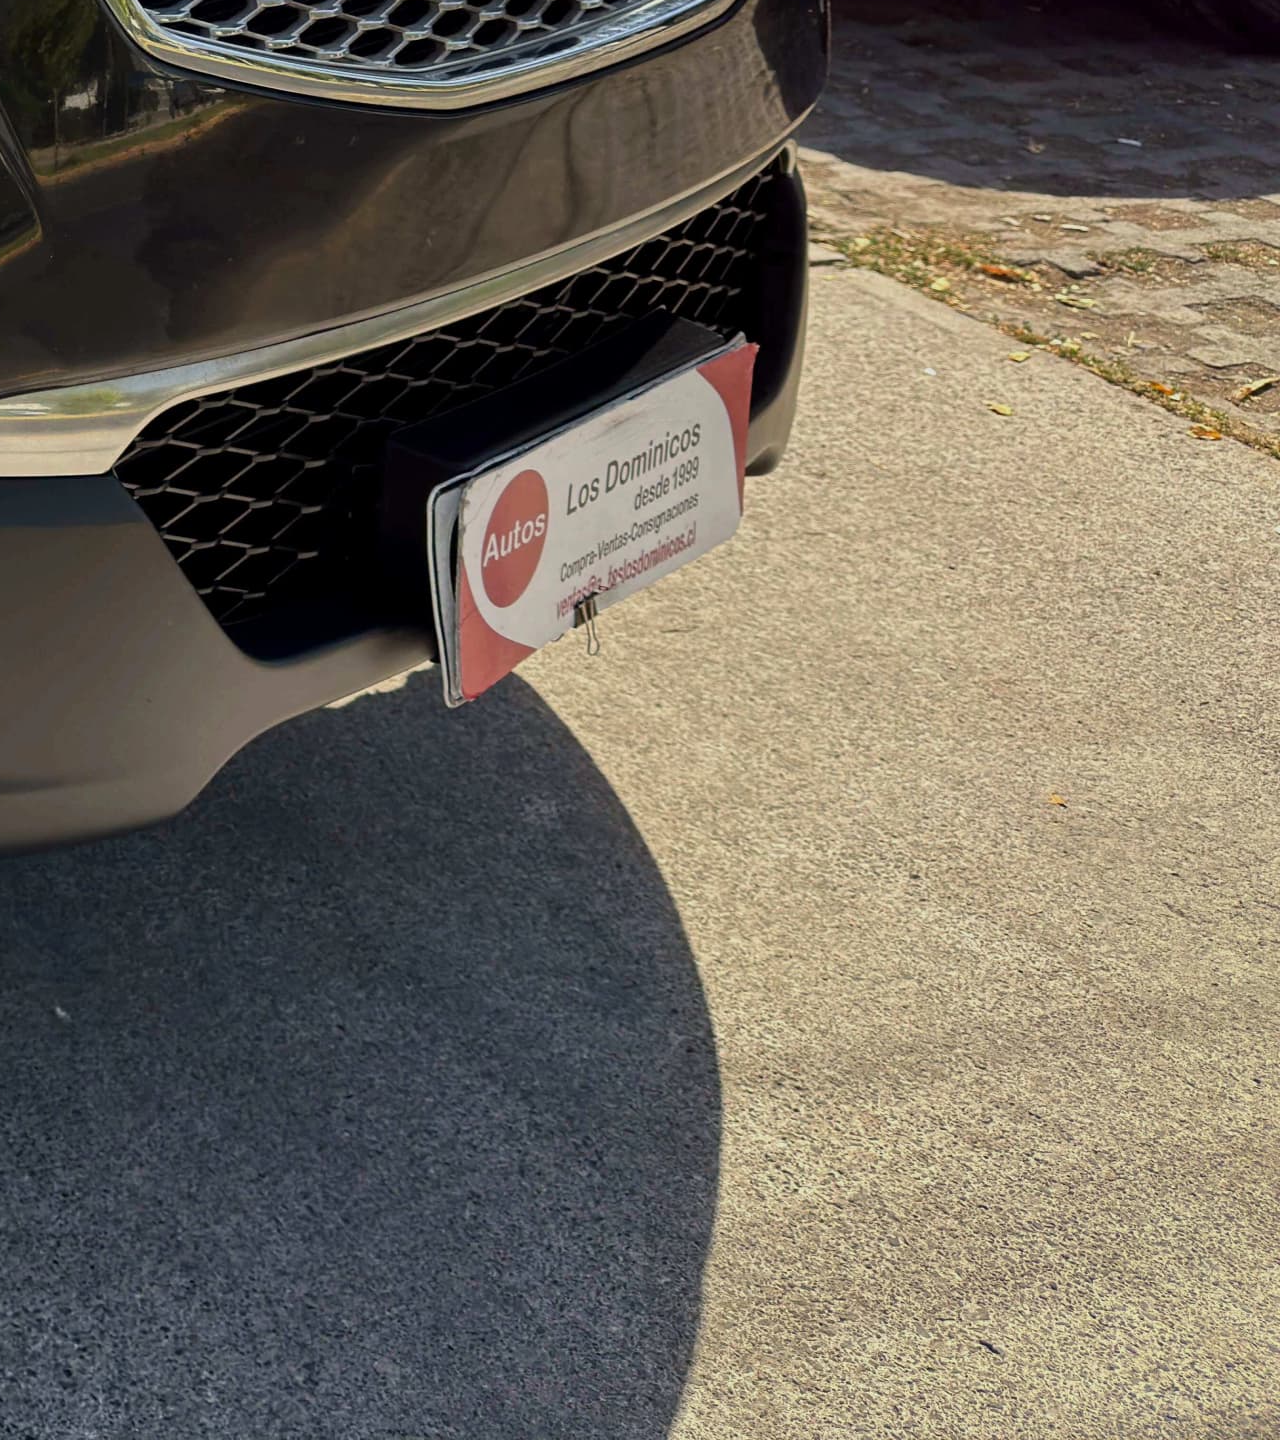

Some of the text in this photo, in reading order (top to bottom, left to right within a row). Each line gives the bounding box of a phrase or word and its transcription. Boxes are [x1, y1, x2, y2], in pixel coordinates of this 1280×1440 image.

[566, 422, 702, 516] Los Dominicos
[634, 456, 700, 511] desde 1999
[482, 512, 546, 568] Autos
